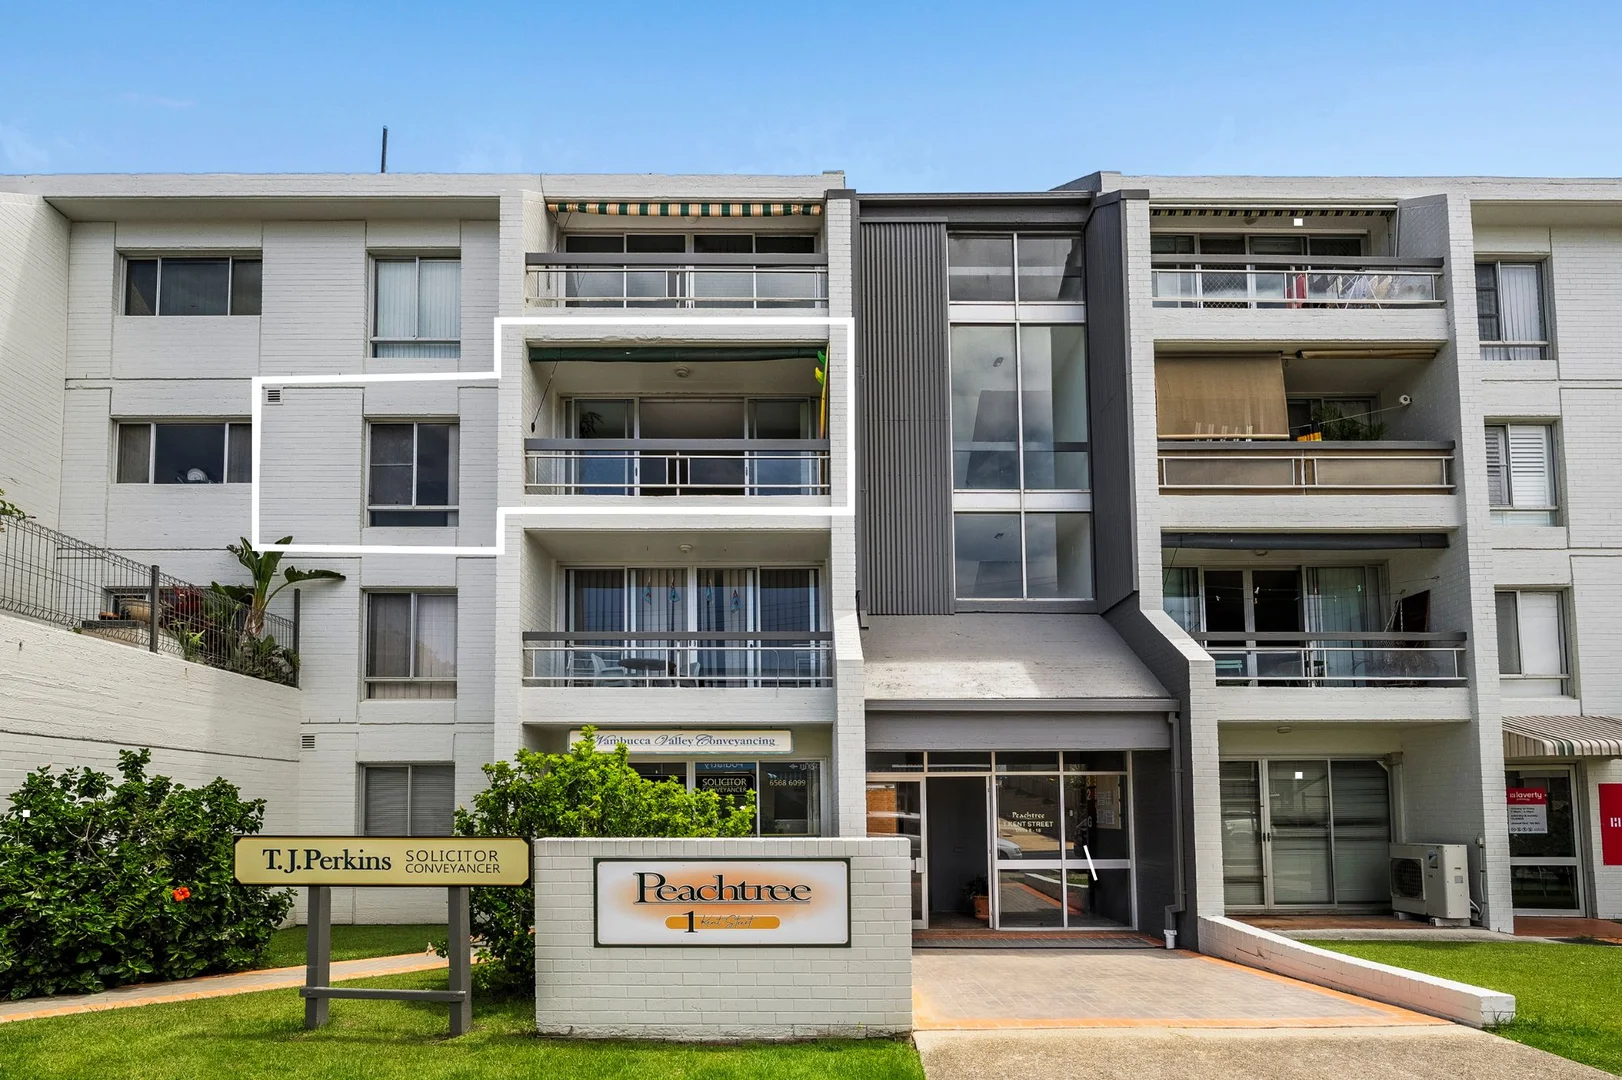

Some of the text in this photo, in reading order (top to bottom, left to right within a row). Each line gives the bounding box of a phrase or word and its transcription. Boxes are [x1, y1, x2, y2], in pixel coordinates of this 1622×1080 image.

[654, 733, 694, 748] Valley
[696, 733, 776, 748] Conveyancing
[702, 778, 747, 787] SOLICITOR
[769, 779, 806, 787] 6568 6099
[1086, 789, 1091, 800] 2
[1516, 791, 1542, 800] laverty
[1012, 811, 1045, 820] Peachtree
[1027, 820, 1054, 828] STREET
[1087, 816, 1093, 828] G
[405, 850, 498, 862] SOLICITOR
[405, 863, 500, 874] CONVEYANCER
[633, 872, 812, 905] Peachtree
[682, 910, 698, 933] 1
